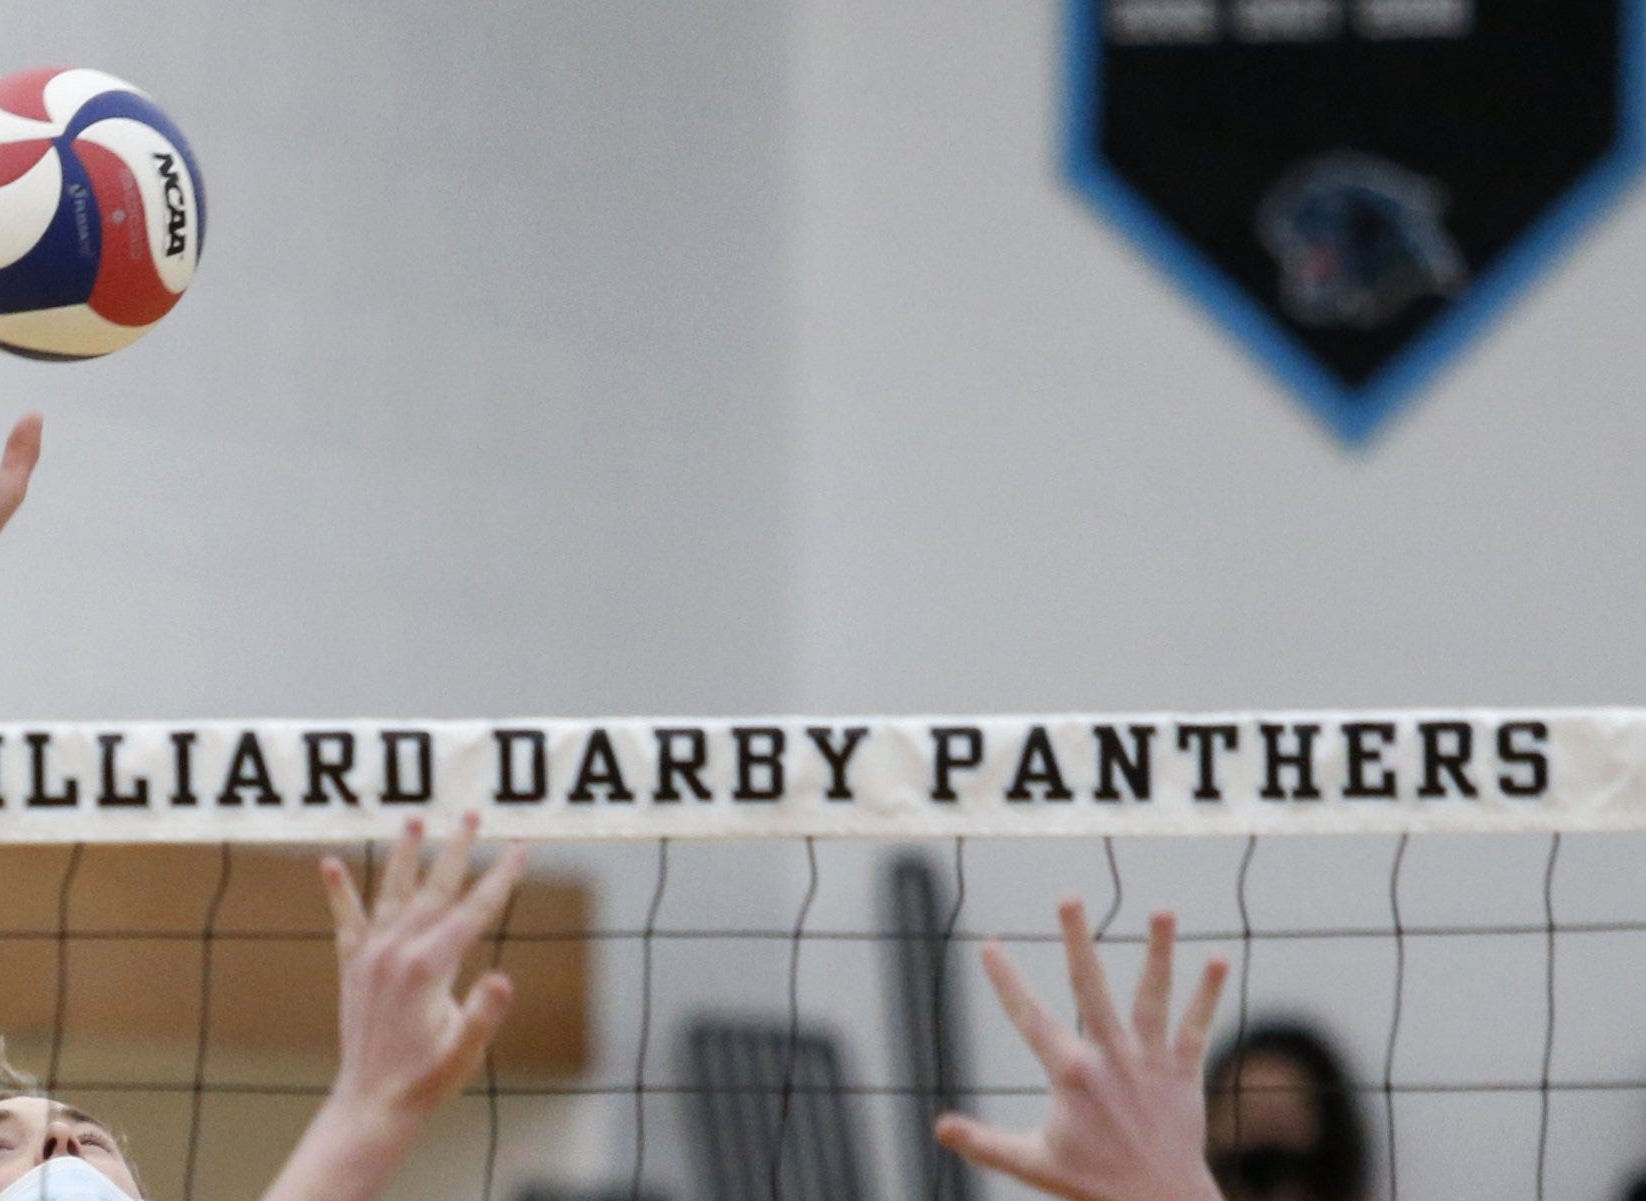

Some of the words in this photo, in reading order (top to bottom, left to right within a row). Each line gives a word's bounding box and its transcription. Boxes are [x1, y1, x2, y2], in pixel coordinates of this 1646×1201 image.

[152, 153, 186, 257] NCAA
[493, 727, 869, 805] DARBY
[930, 721, 1549, 804] PANTHERS
